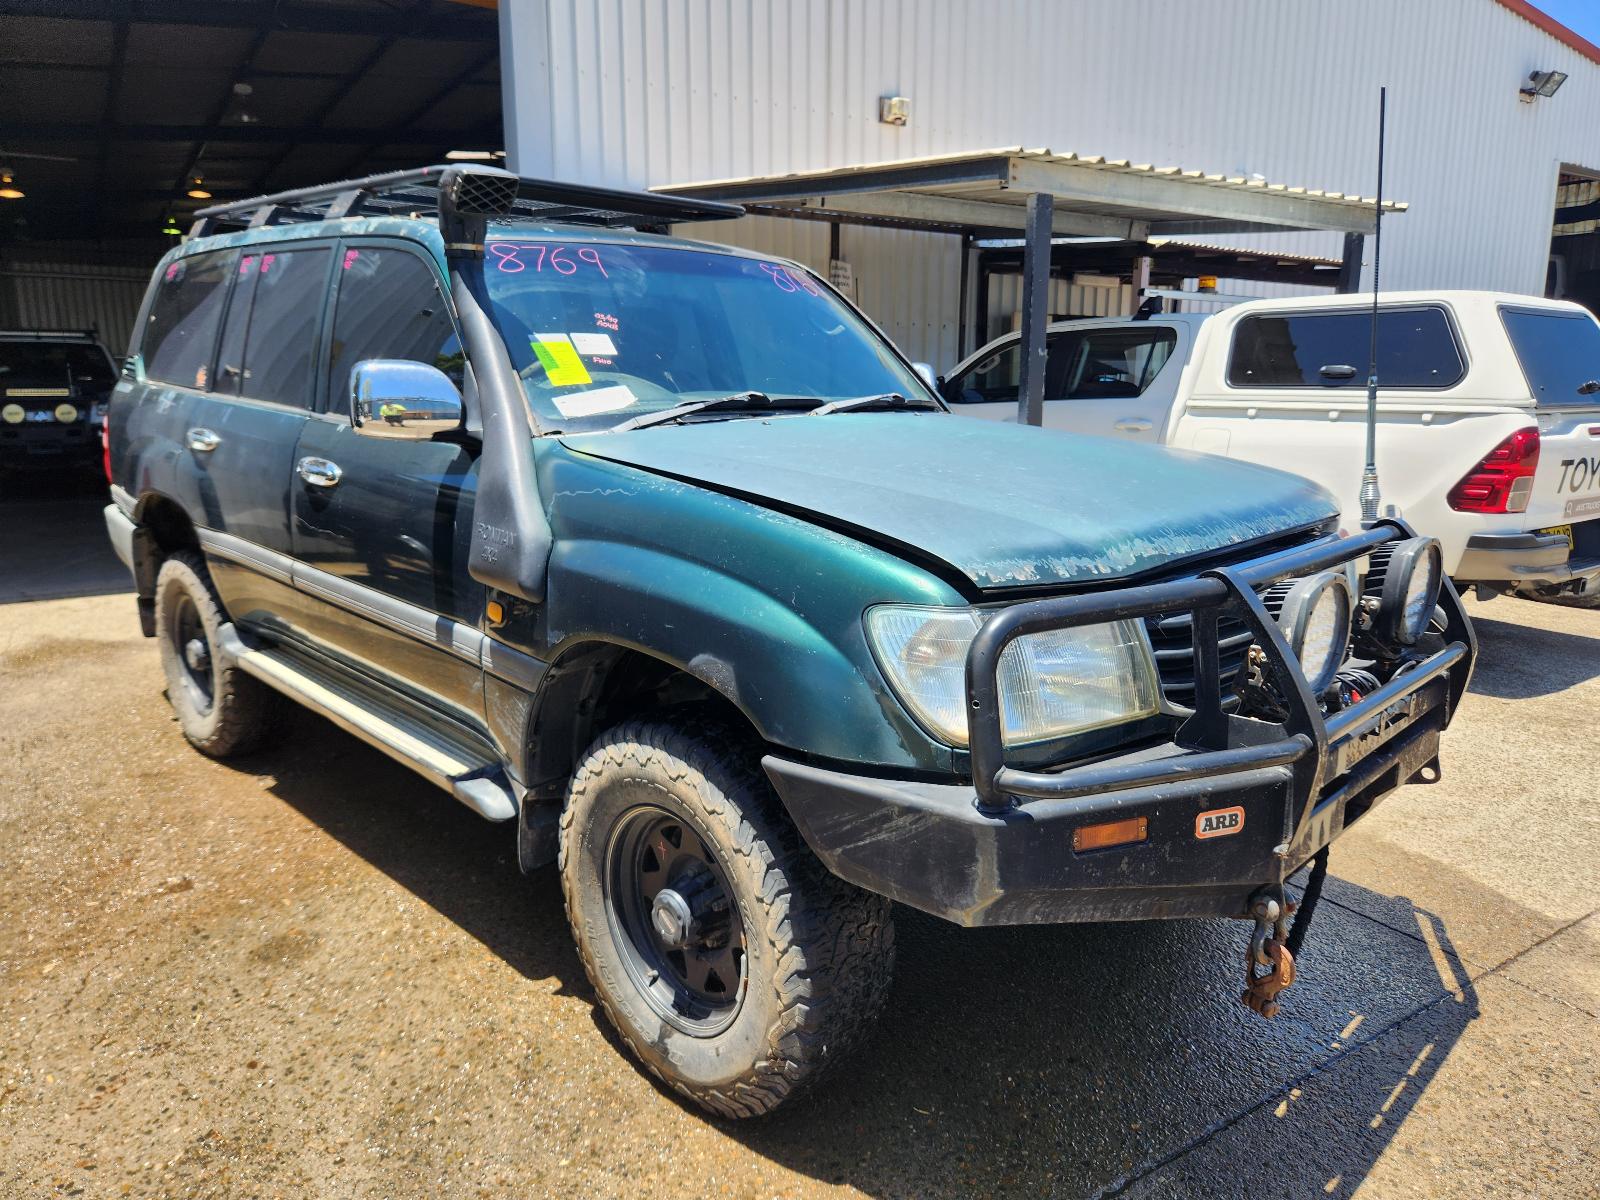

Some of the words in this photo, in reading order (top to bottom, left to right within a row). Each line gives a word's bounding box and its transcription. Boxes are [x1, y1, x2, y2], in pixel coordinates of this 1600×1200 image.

[489, 242, 609, 279] 8769
[1556, 457, 1600, 494] TOY
[1201, 812, 1239, 833] ARB
